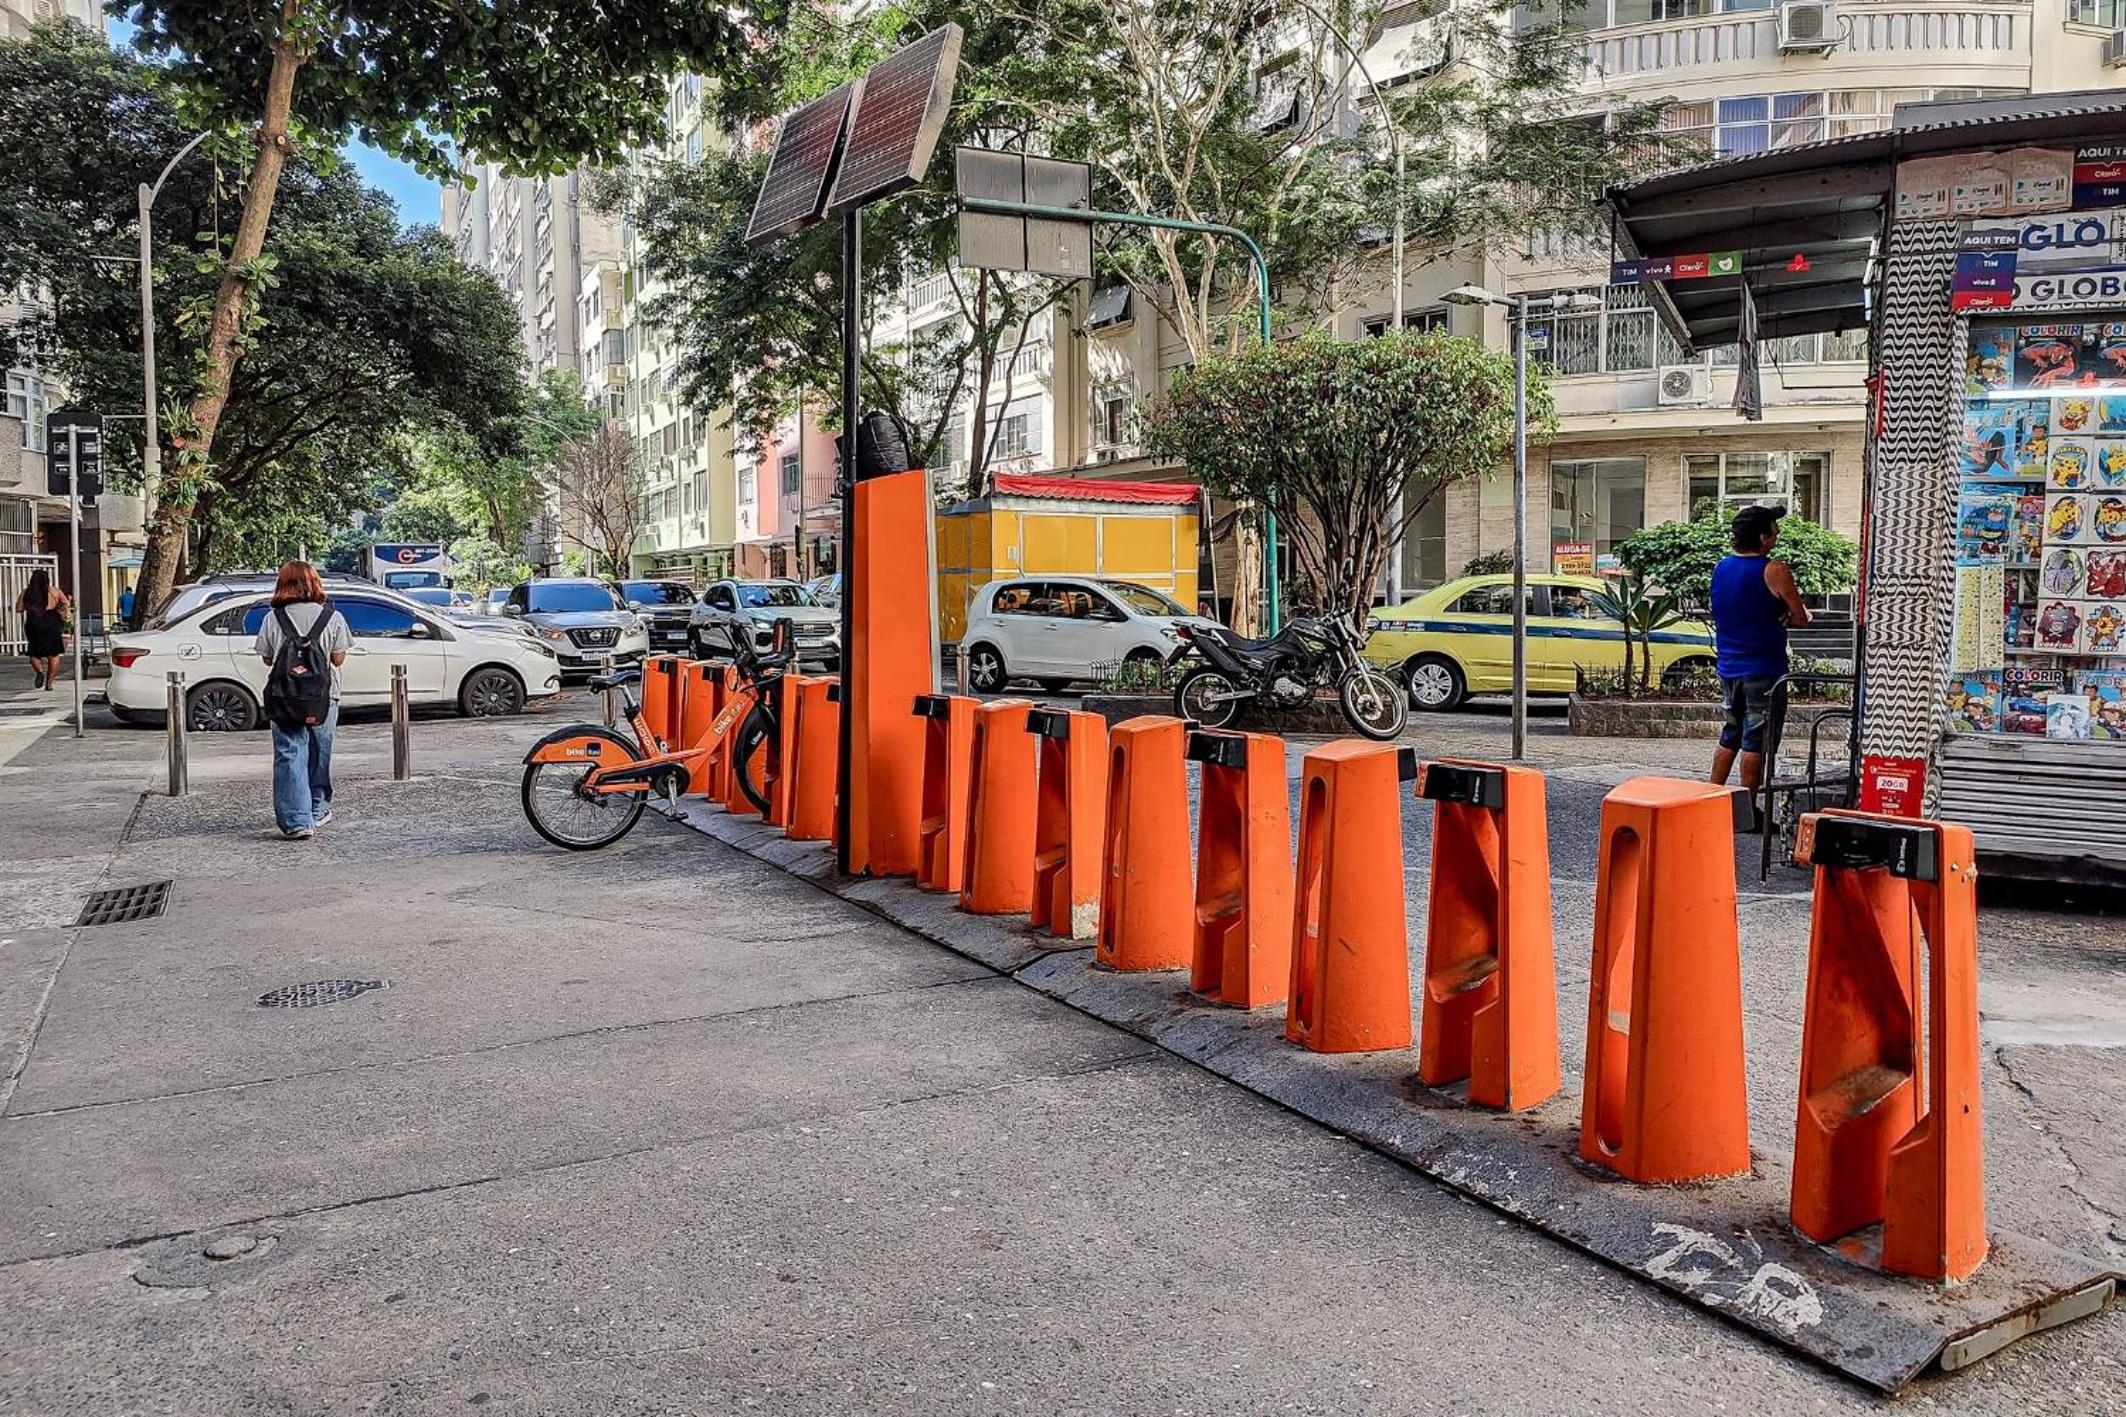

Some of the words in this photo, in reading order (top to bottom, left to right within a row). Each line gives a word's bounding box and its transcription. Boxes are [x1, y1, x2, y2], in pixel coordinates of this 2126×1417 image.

[2077, 147, 2111, 158] AQUI
[2102, 187, 2119, 195] TIM
[1963, 236, 1991, 244] AQUI
[1993, 235, 2016, 244] TEM
[1622, 268, 1638, 276] TIM
[1645, 267, 1664, 275] vivo
[1679, 262, 1703, 272] Claro
[2031, 276, 2126, 301] GLOB
[2020, 324, 2081, 337] COLORIR
[2006, 669, 2063, 682] COLORIR
[713, 715, 732, 735] bike
[566, 747, 585, 756] bike
